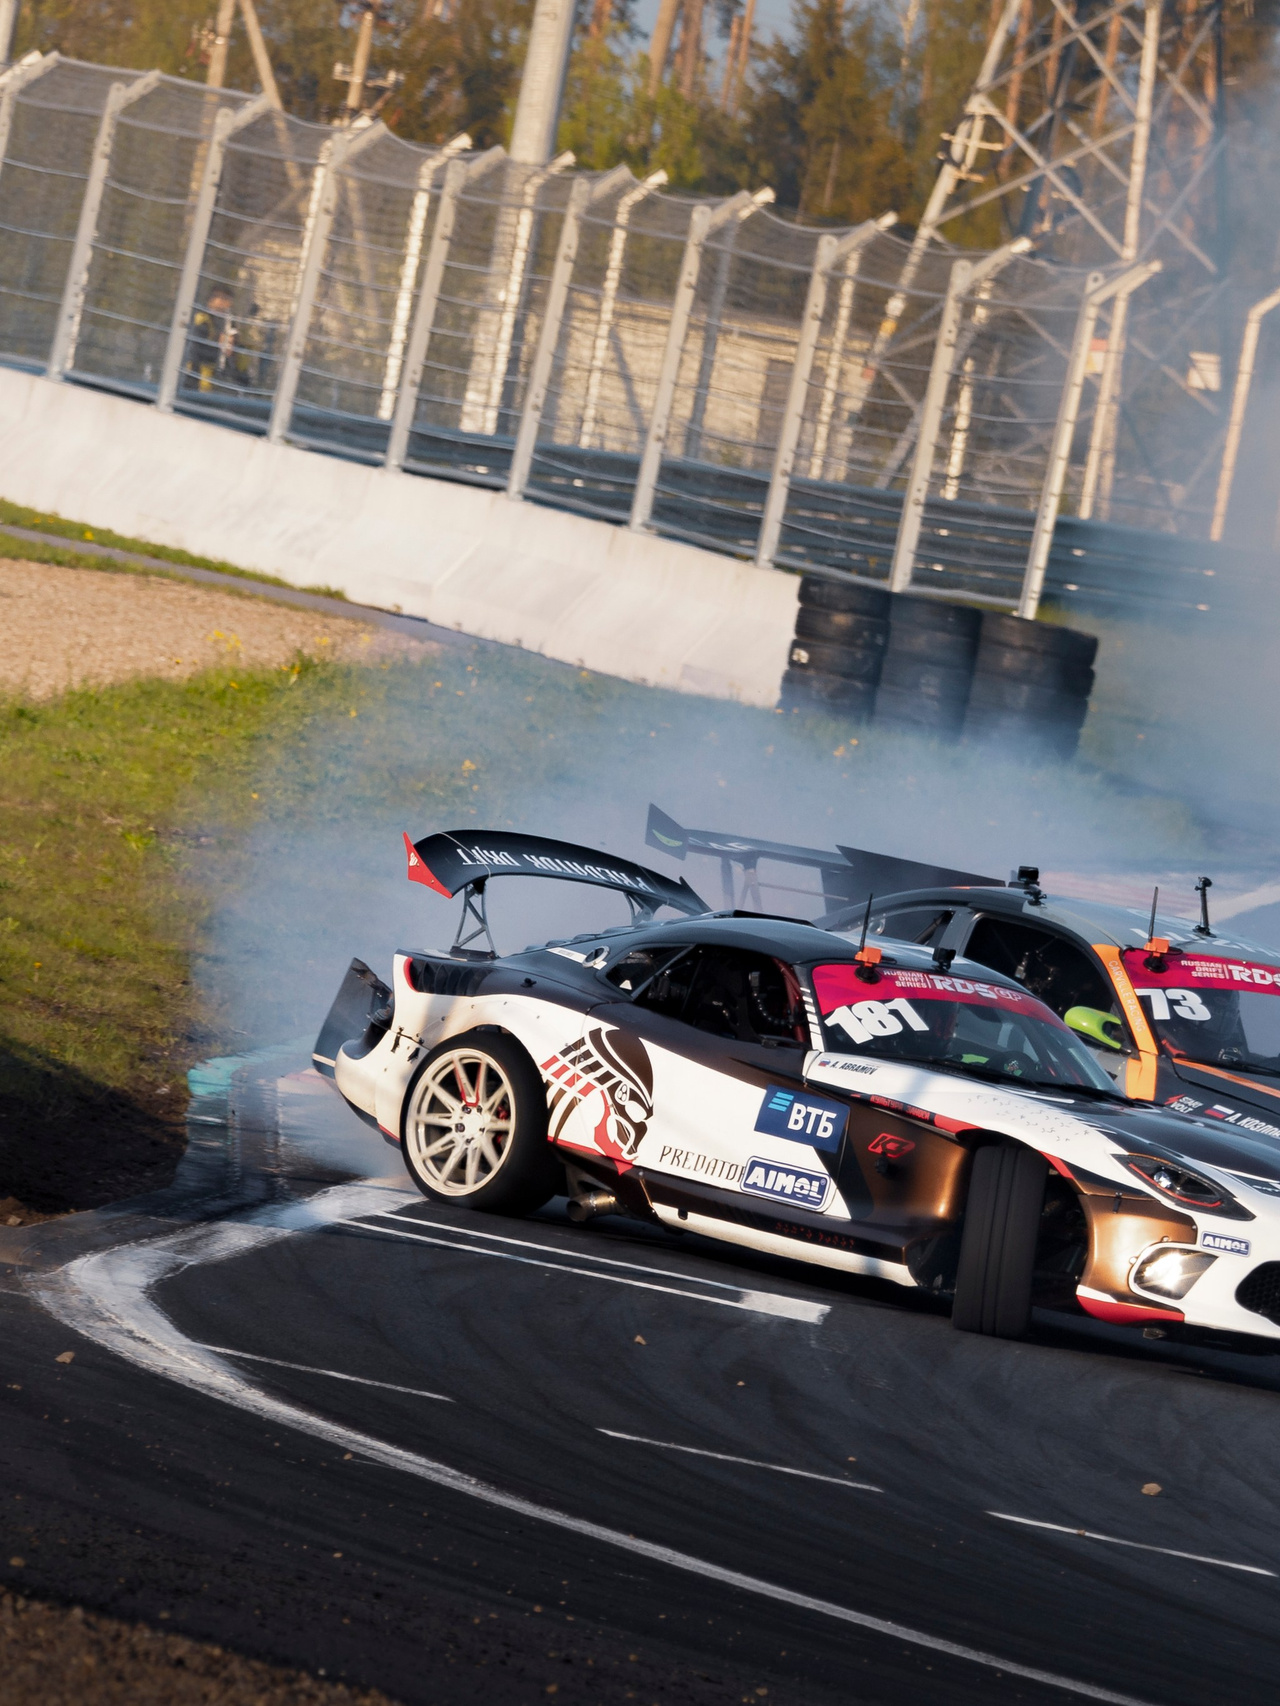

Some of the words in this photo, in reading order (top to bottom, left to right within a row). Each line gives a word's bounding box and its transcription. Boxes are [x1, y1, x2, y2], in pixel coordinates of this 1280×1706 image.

[457, 846, 522, 867] DRIFT
[523, 853, 656, 893] PREDATOR
[1181, 960, 1222, 968] RUSSIAN
[895, 980, 927, 988] SERIES
[1191, 971, 1225, 979] SERIES
[928, 974, 998, 999] RDS
[1108, 960, 1132, 998] CARVILLE
[1127, 998, 1146, 1032] RACING
[1134, 988, 1211, 1021] 73
[824, 998, 929, 1045] 181
[839, 1062, 878, 1075] ABRAMOV
[1170, 1101, 1194, 1114] VOLT
[1178, 1096, 1204, 1109] START
[787, 1102, 837, 1139] ВТБ
[1202, 1234, 1248, 1253] AIMOL
